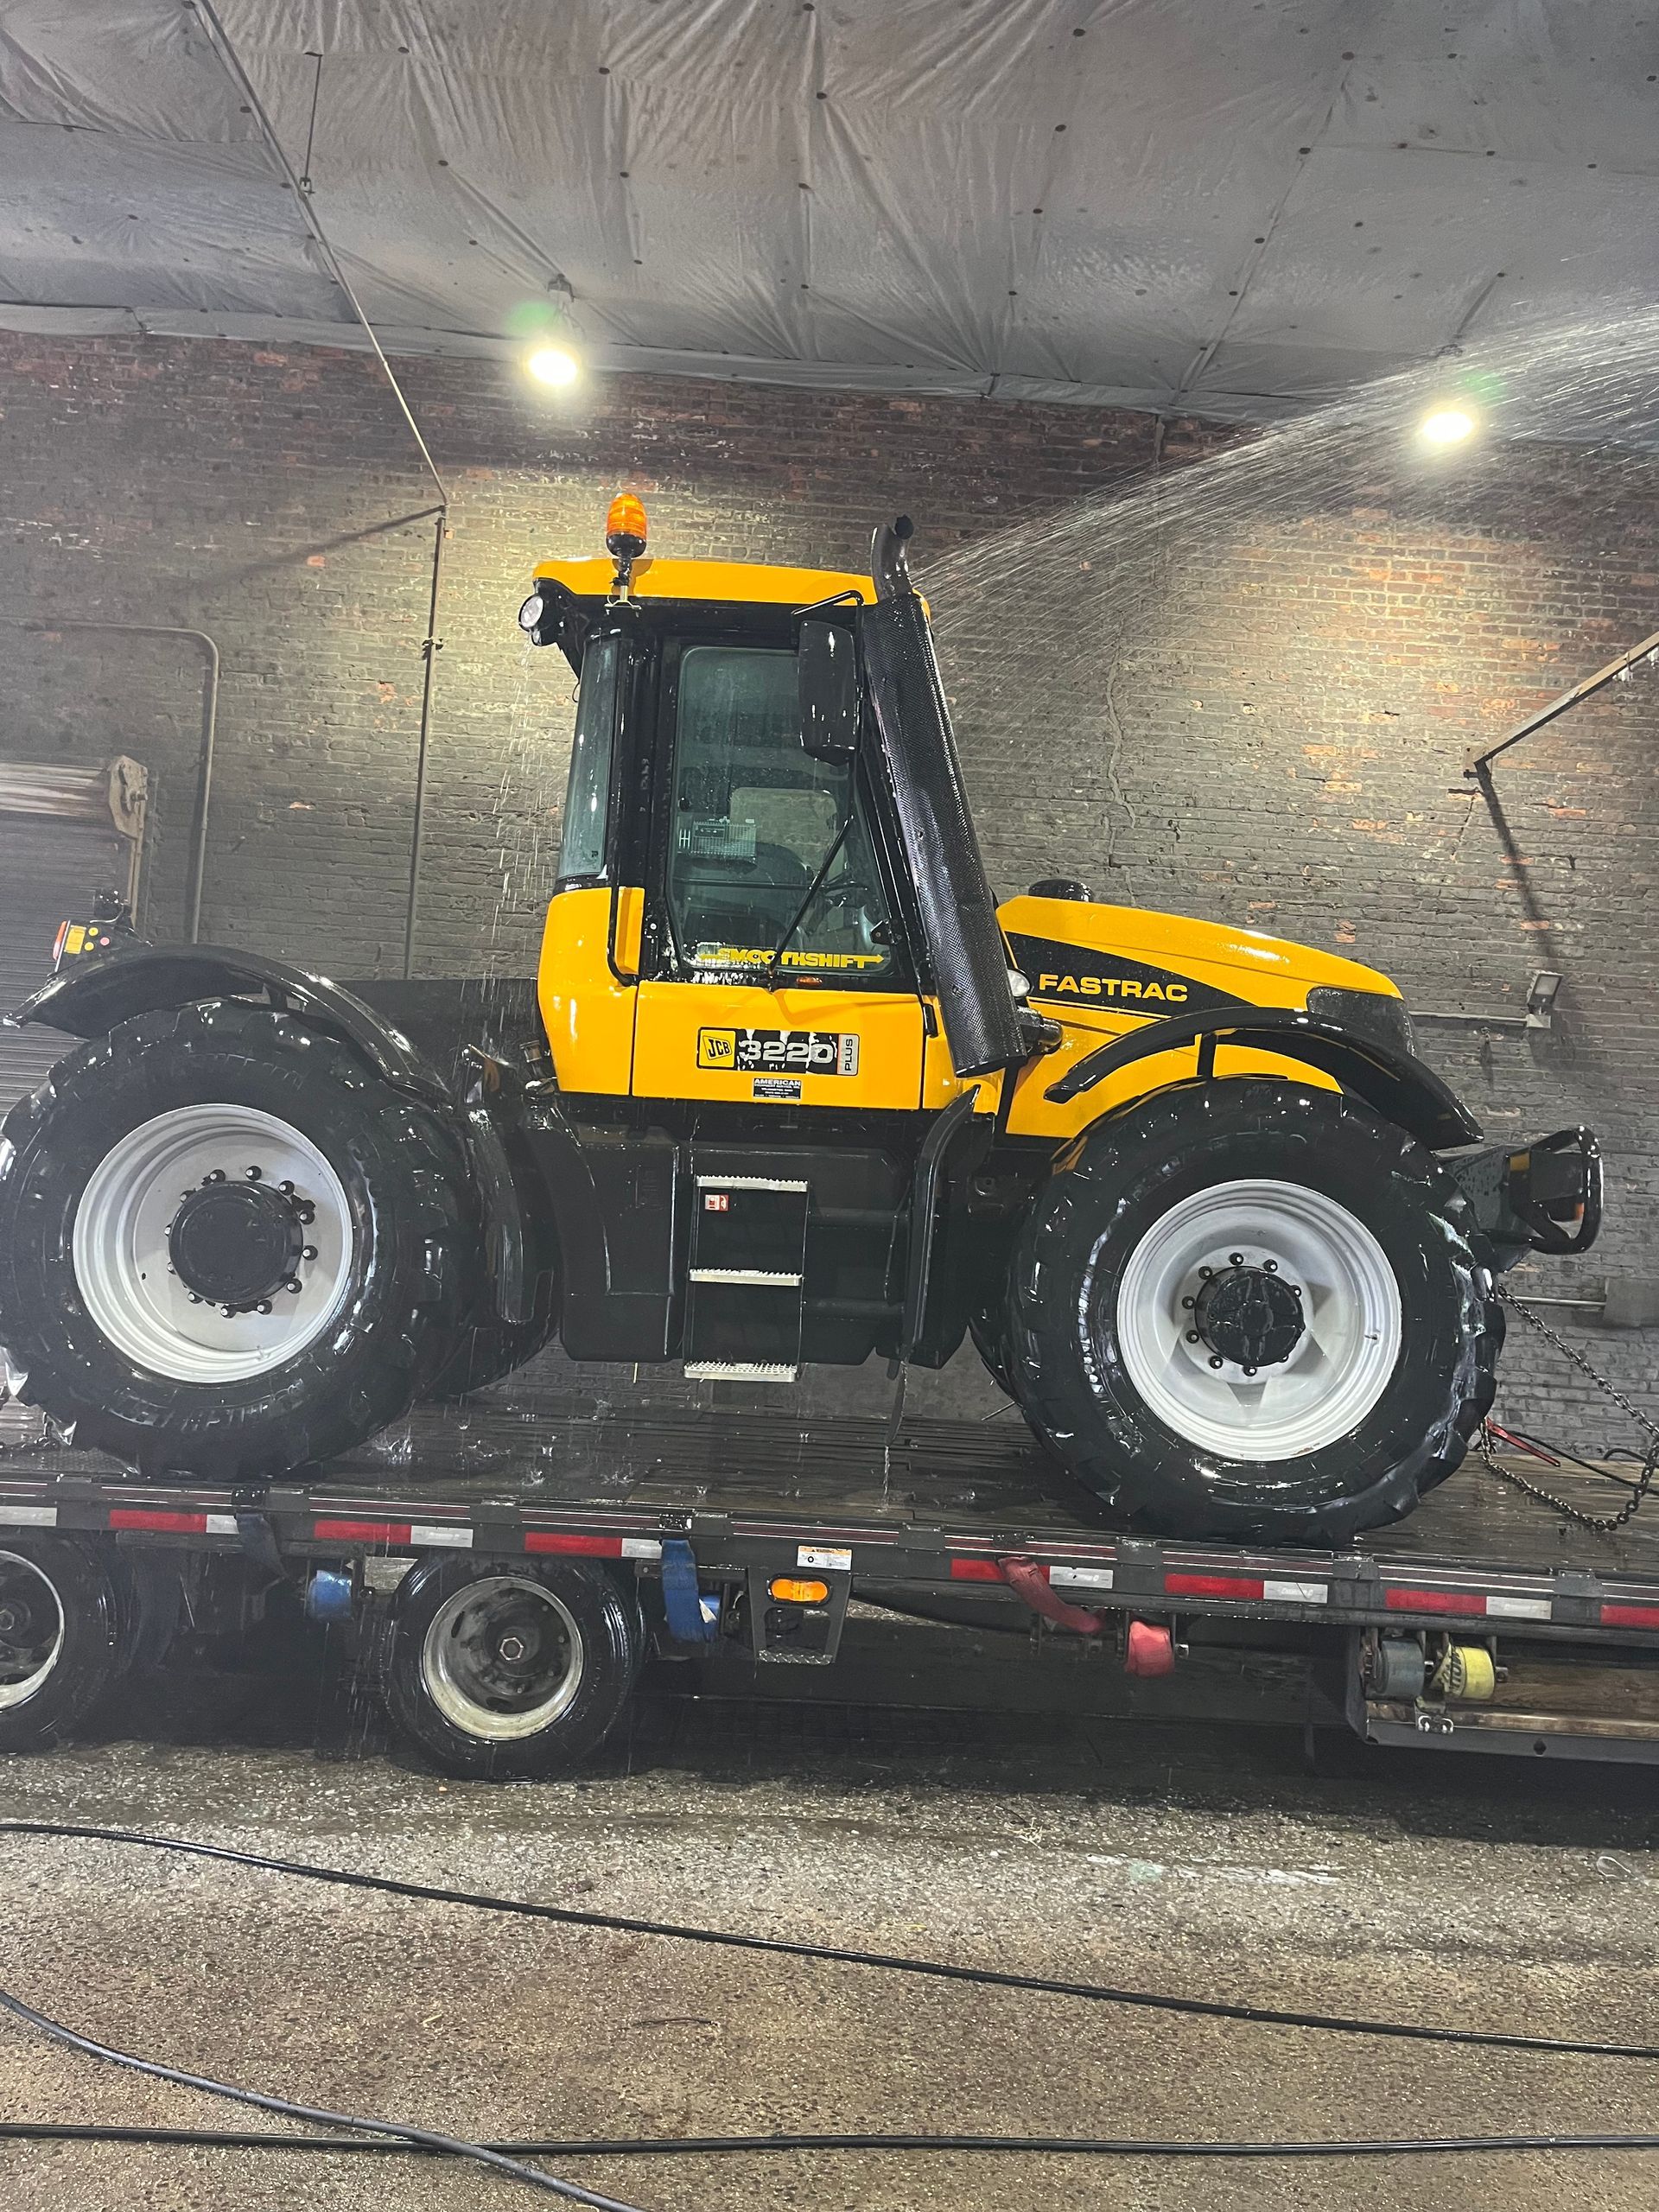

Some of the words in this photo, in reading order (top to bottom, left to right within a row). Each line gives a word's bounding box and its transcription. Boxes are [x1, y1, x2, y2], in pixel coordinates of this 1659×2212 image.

[1039, 973, 1188, 1002] FASTRAC
[708, 1038, 730, 1058] JCB
[738, 1039, 834, 1064] 3220
[844, 1039, 854, 1071] PLUS
